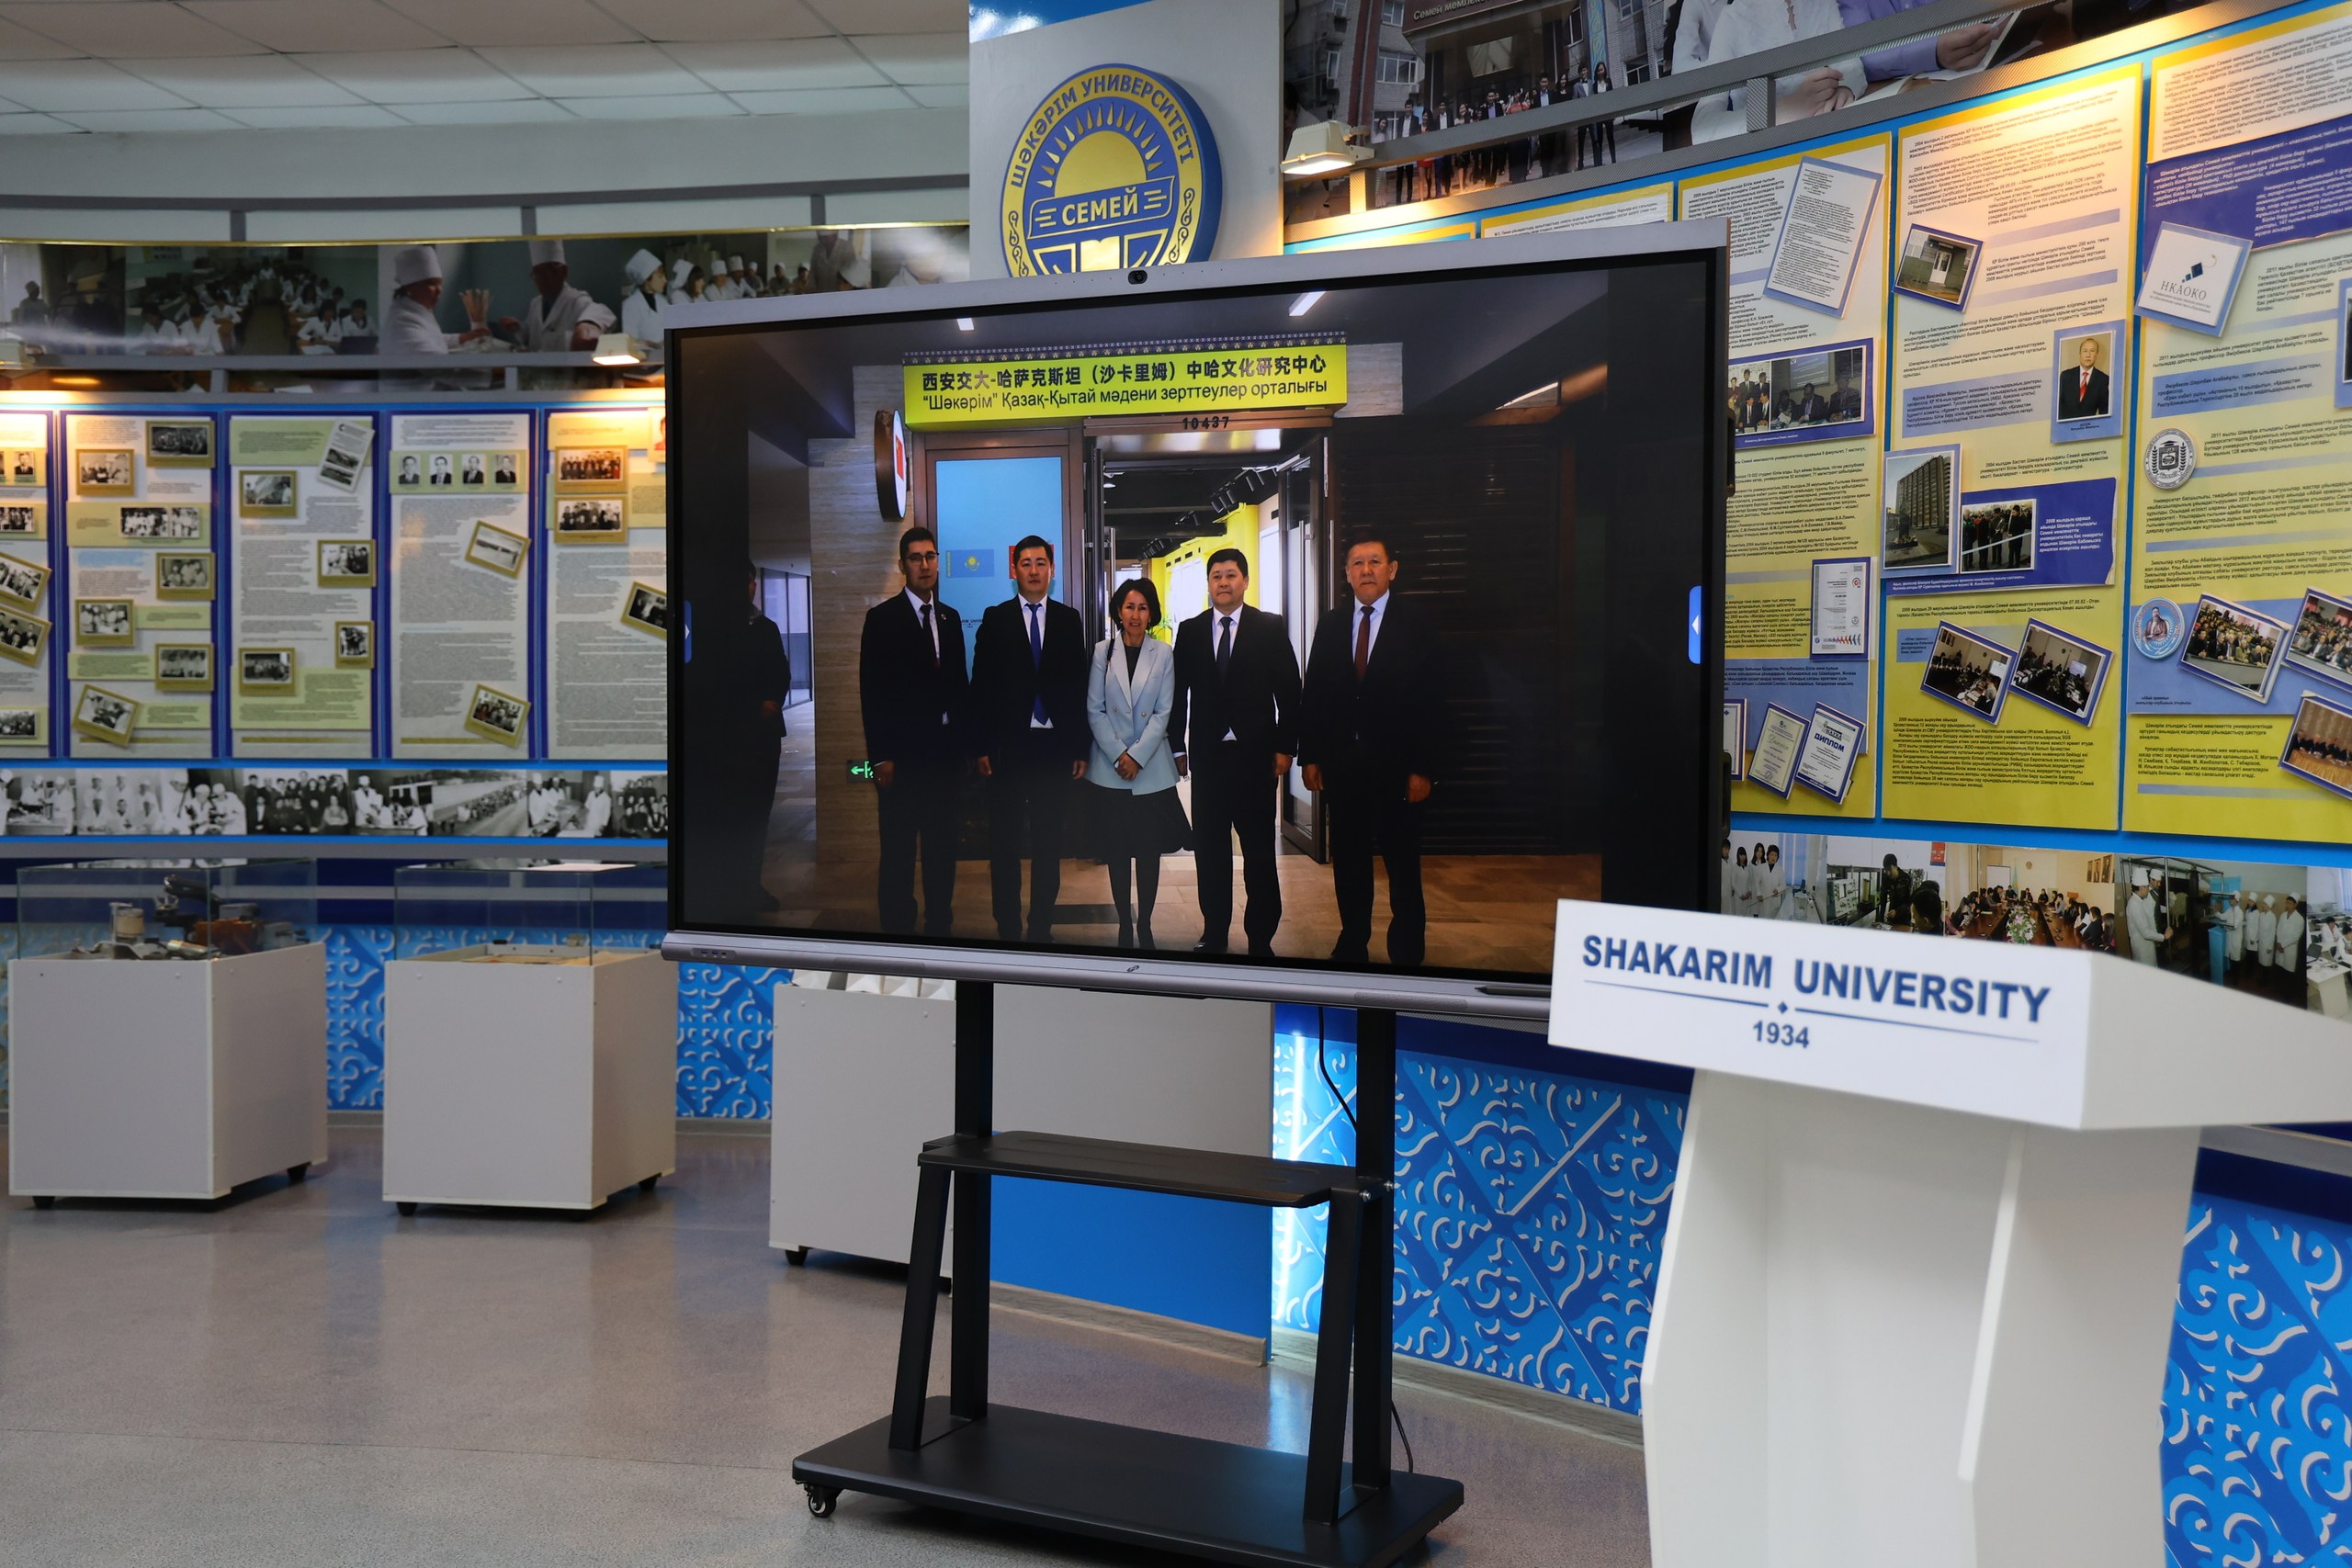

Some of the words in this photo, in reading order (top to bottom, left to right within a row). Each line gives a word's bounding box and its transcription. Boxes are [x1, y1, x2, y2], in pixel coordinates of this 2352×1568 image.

[1413, 5, 1443, 20] Семей
[1011, 87, 1078, 188] ШӘКӘРІМ
[1081, 73, 1194, 164] УНИВЕРСИТЕТІ
[1061, 186, 1138, 226] СЕМЕЙ
[2160, 280, 2207, 300] НКАОКО
[923, 392, 999, 412] “Шәкәрім”
[1002, 388, 1096, 411] Қазақ-Қытай
[1100, 388, 1157, 404] мәдени
[1160, 385, 1247, 403] зерттеулер
[1251, 380, 1328, 401] орталығы
[1182, 416, 1230, 430] 10437
[1814, 732, 1845, 752] ДИПЛОМ
[1581, 933, 1773, 989] SHAKARIM
[1793, 958, 2052, 1024] UNIVERSITY
[1752, 1019, 1811, 1049] 1934
